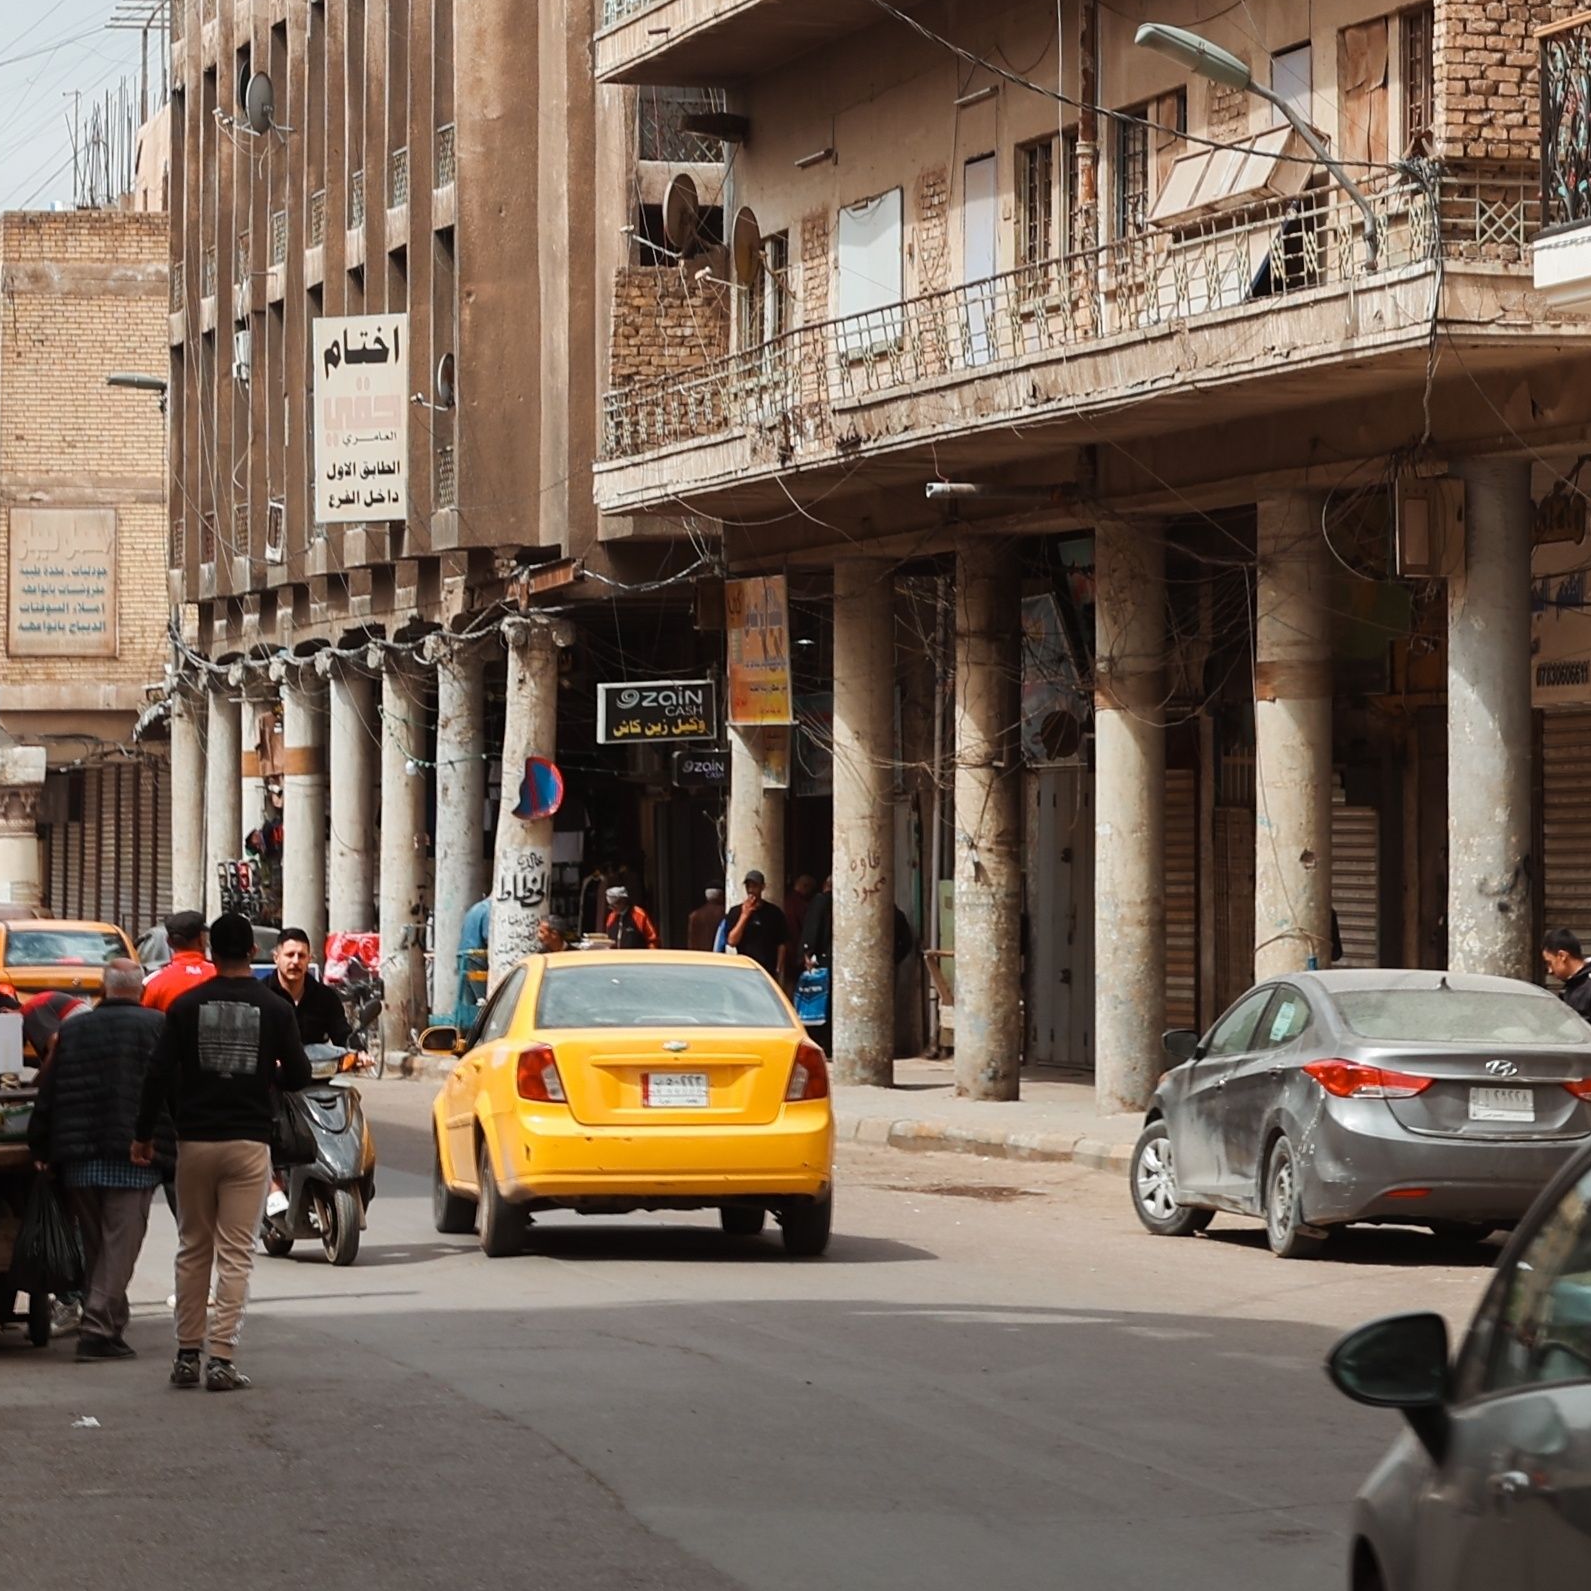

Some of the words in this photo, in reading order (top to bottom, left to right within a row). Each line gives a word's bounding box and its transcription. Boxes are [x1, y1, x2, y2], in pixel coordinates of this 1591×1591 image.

[324, 324, 400, 378] اختام
[342, 430, 397, 447] العامري
[326, 461, 356, 481] الاول
[360, 460, 401, 481] الطابق
[328, 488, 360, 510] الفرع
[363, 488, 400, 508] داخل
[665, 705, 703, 717] CASH
[644, 718, 669, 736] زين
